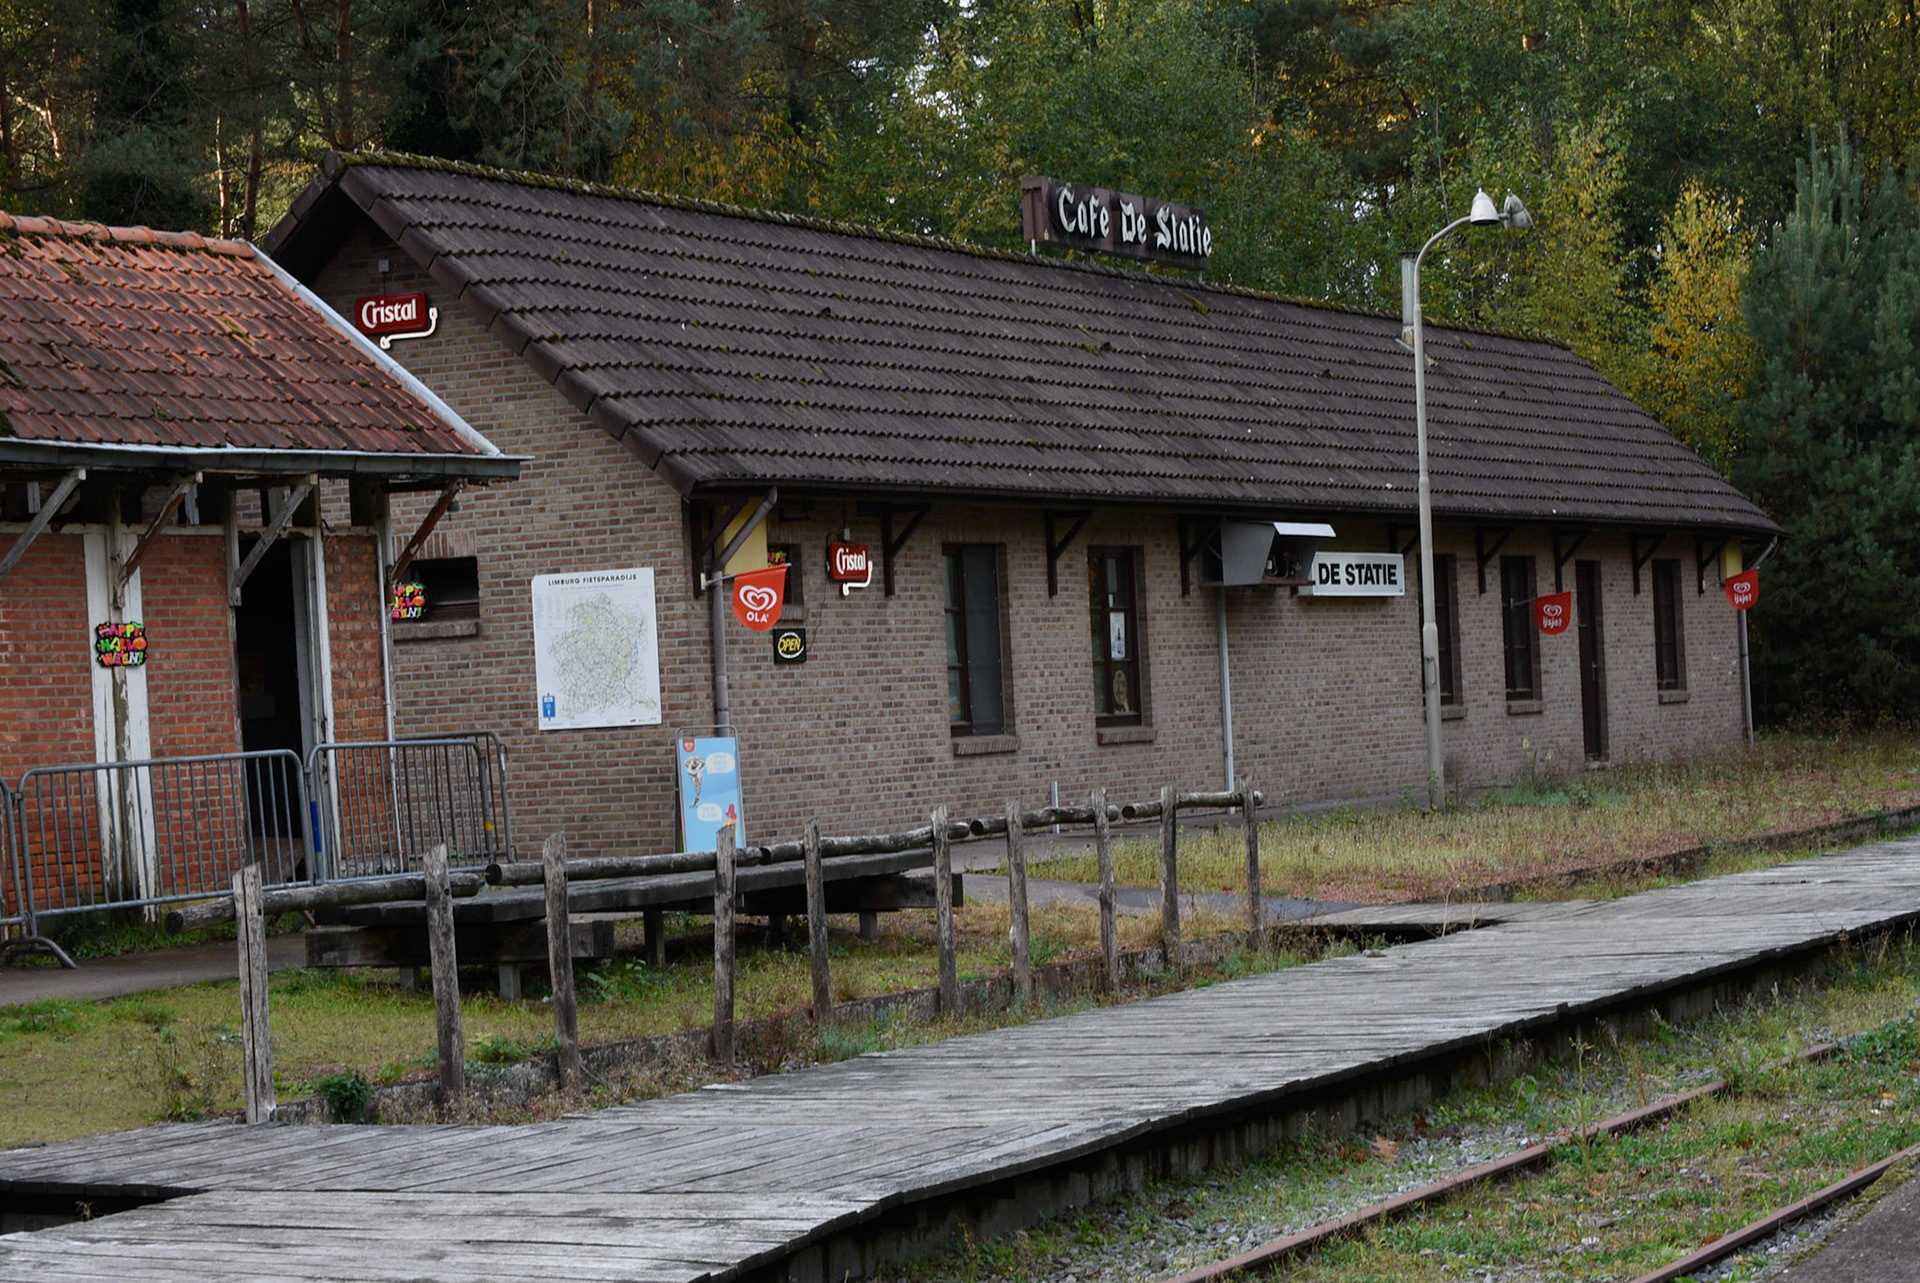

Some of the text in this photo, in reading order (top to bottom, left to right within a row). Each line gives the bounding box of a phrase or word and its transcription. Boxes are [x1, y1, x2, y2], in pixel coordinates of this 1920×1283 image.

[1119, 199, 1147, 244] De
[1154, 205, 1212, 257] Statie
[361, 298, 417, 329] Cristal
[836, 547, 867, 575] Cristal
[548, 574, 637, 586] LIMBURG FIETSPARADIJS
[1318, 563, 1398, 585] DE STATIE
[746, 611, 768, 623] OLA
[98, 623, 143, 638] HAPPY
[99, 637, 147, 652] HALLO
[777, 638, 801, 651] OPEN
[100, 651, 144, 666] WEEN!
